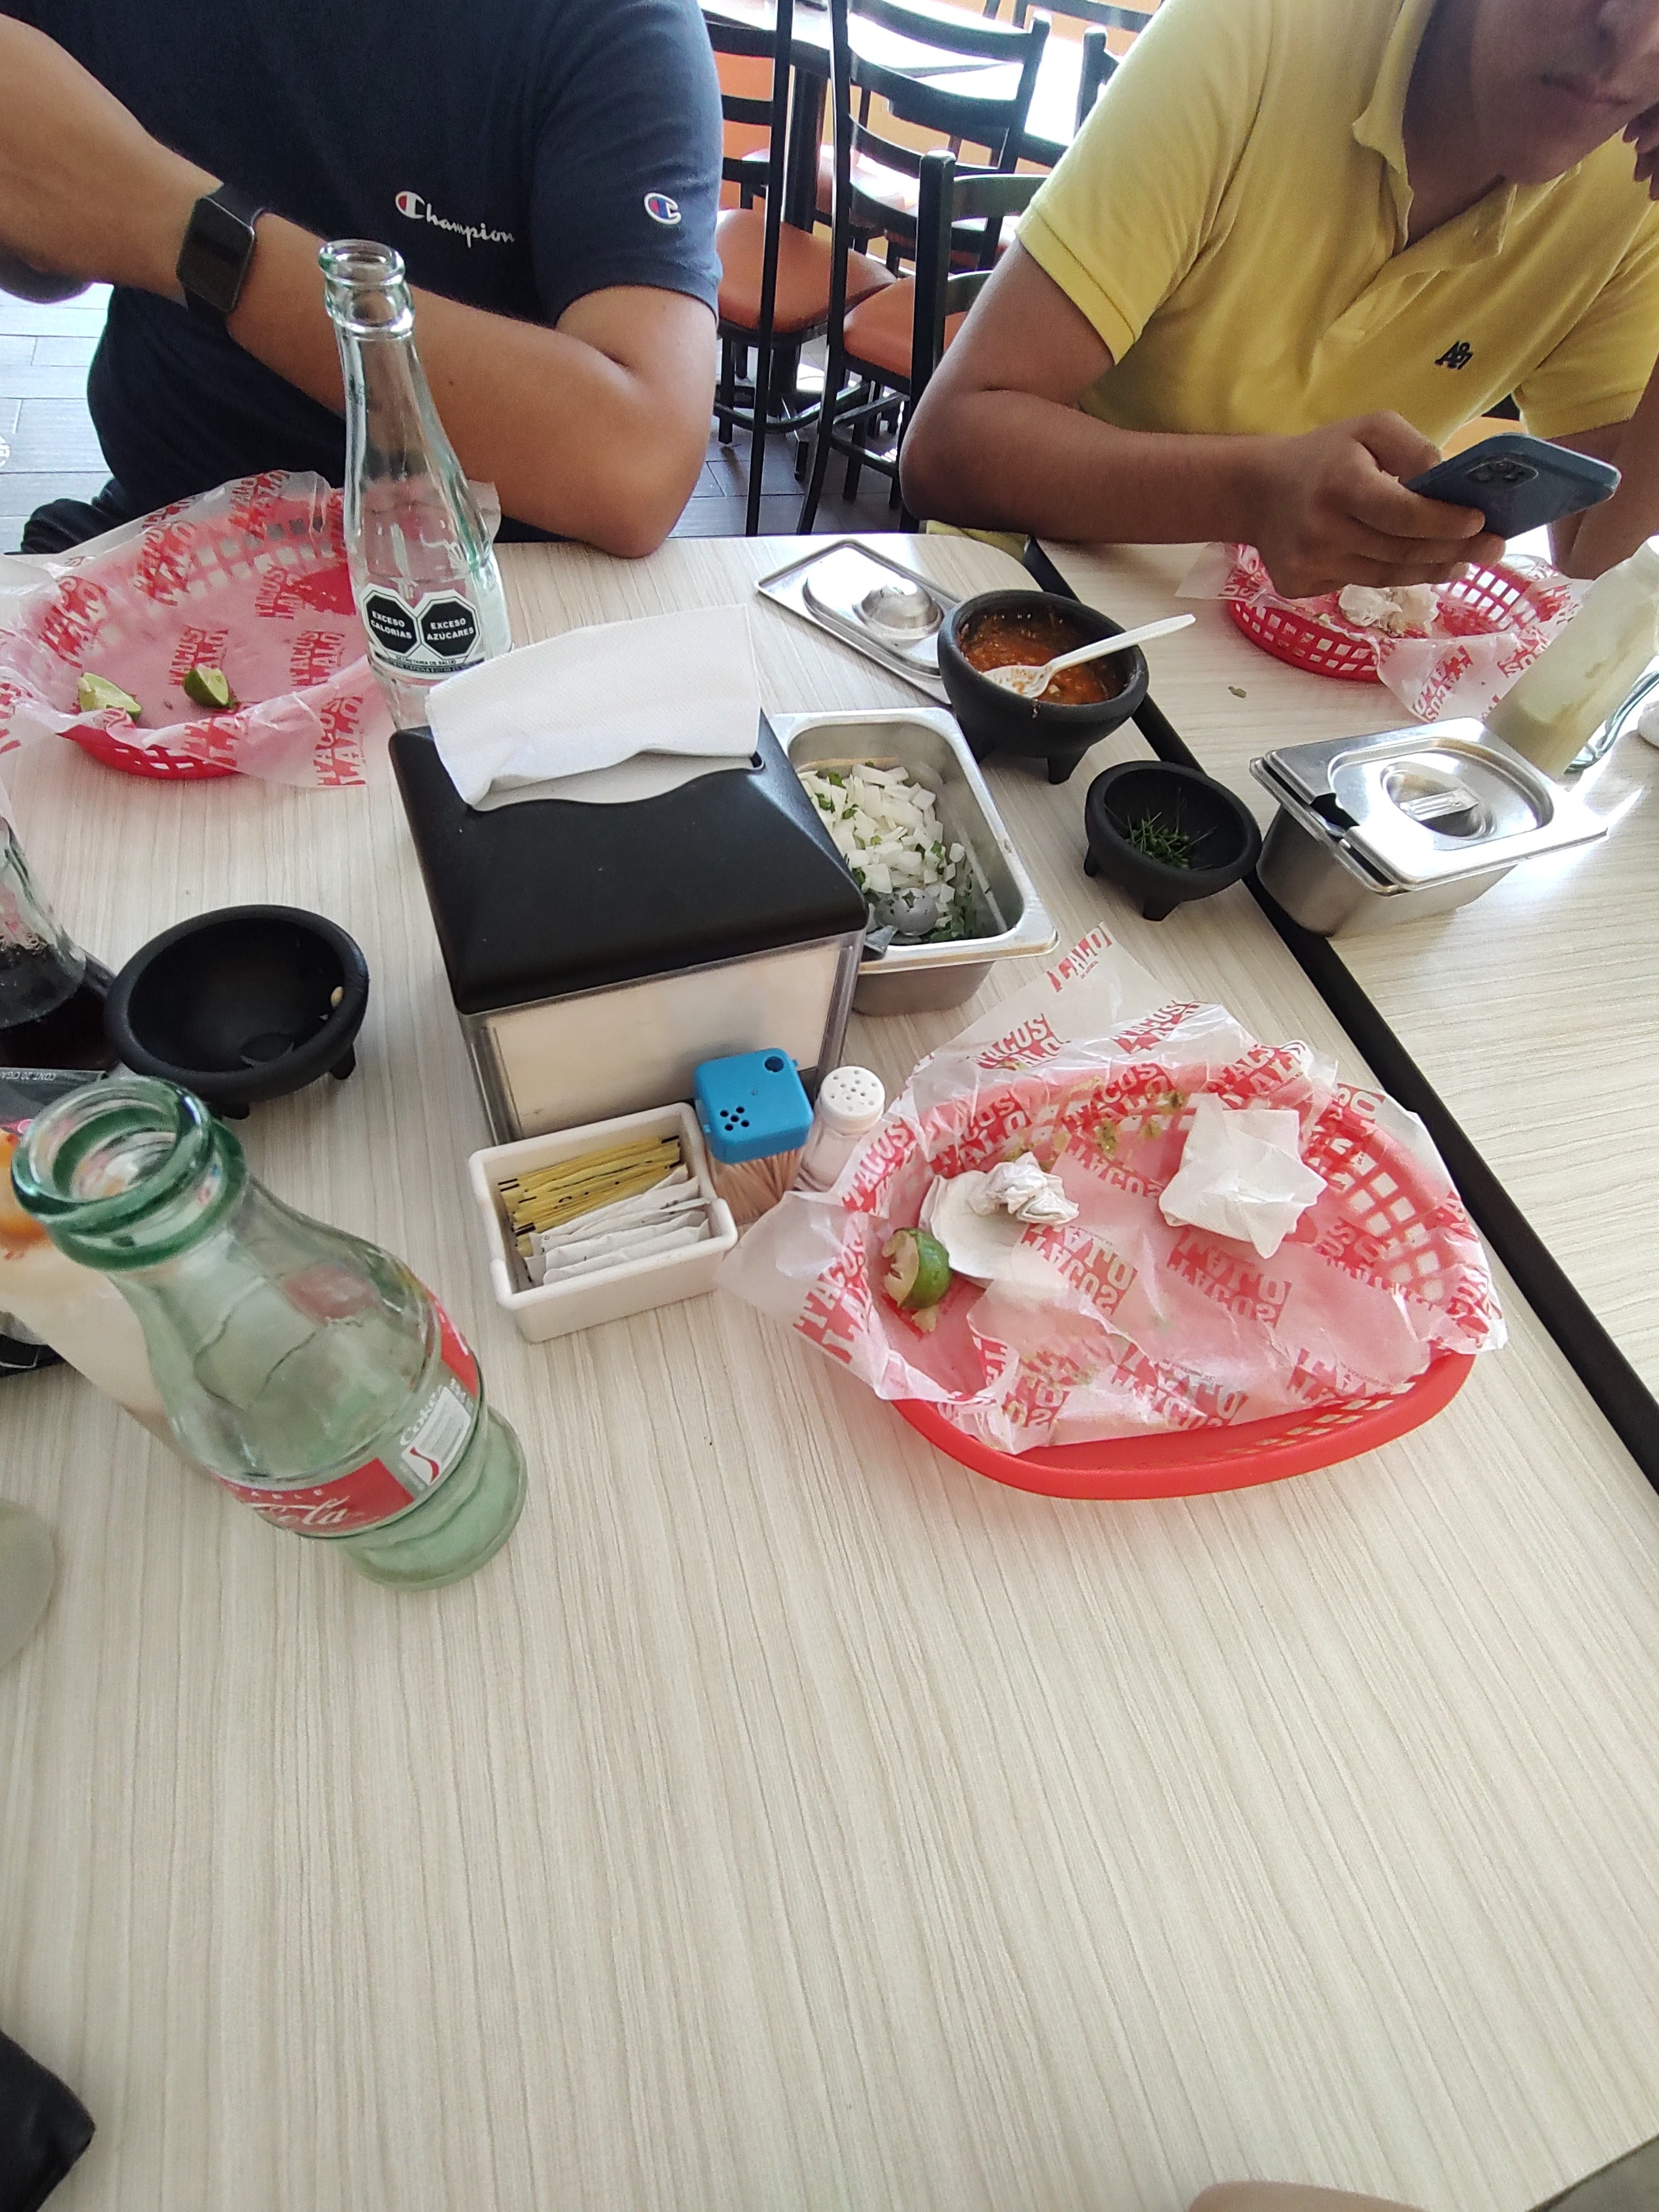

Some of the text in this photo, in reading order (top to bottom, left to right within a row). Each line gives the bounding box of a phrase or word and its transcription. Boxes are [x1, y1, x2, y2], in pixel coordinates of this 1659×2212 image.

[395, 191, 515, 248] Champion
[372, 611, 405, 628] EXCESO
[430, 617, 467, 630] EXCESO
[332, 696, 364, 785] LALO
